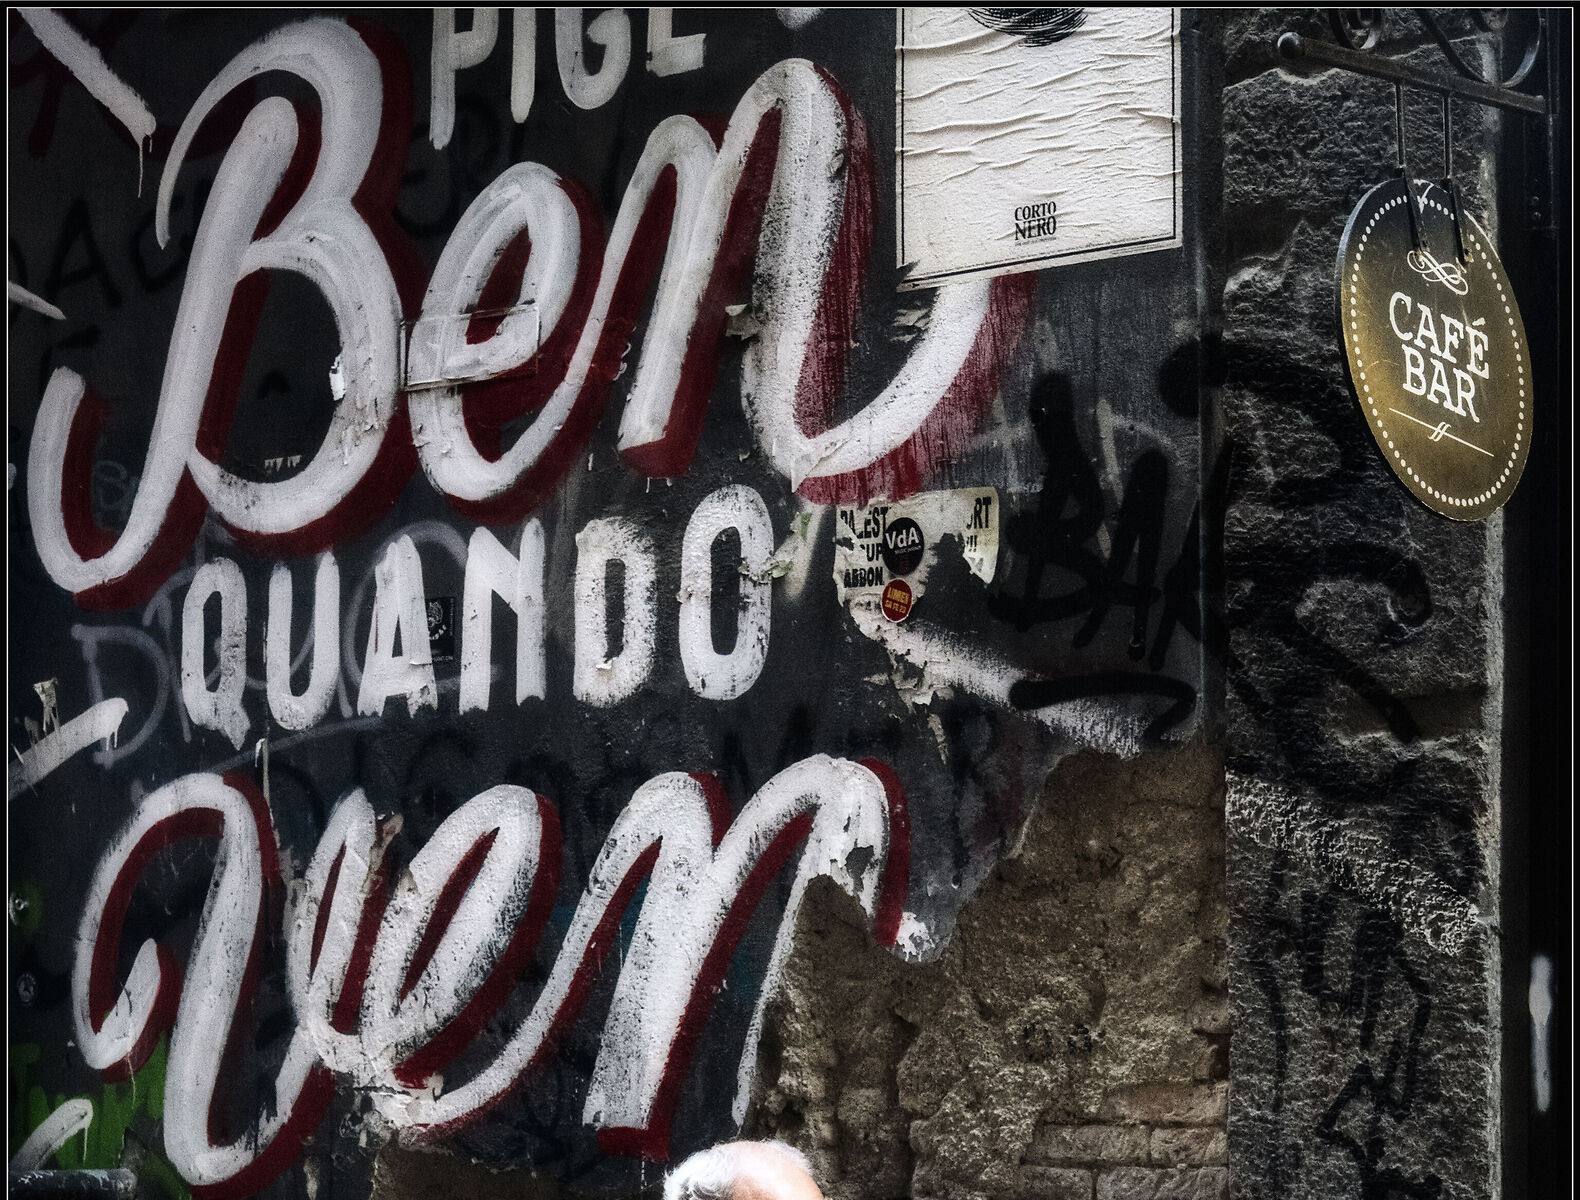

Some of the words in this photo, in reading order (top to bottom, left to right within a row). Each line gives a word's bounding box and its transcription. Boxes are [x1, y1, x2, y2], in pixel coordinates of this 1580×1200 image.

[1014, 201, 1056, 221] CORTO
[1014, 216, 1056, 240] NERO
[1389, 291, 1490, 380] CAFÉ
[1401, 343, 1480, 423] BAR
[885, 527, 919, 550] VdA
[181, 484, 774, 750] QUANDO
